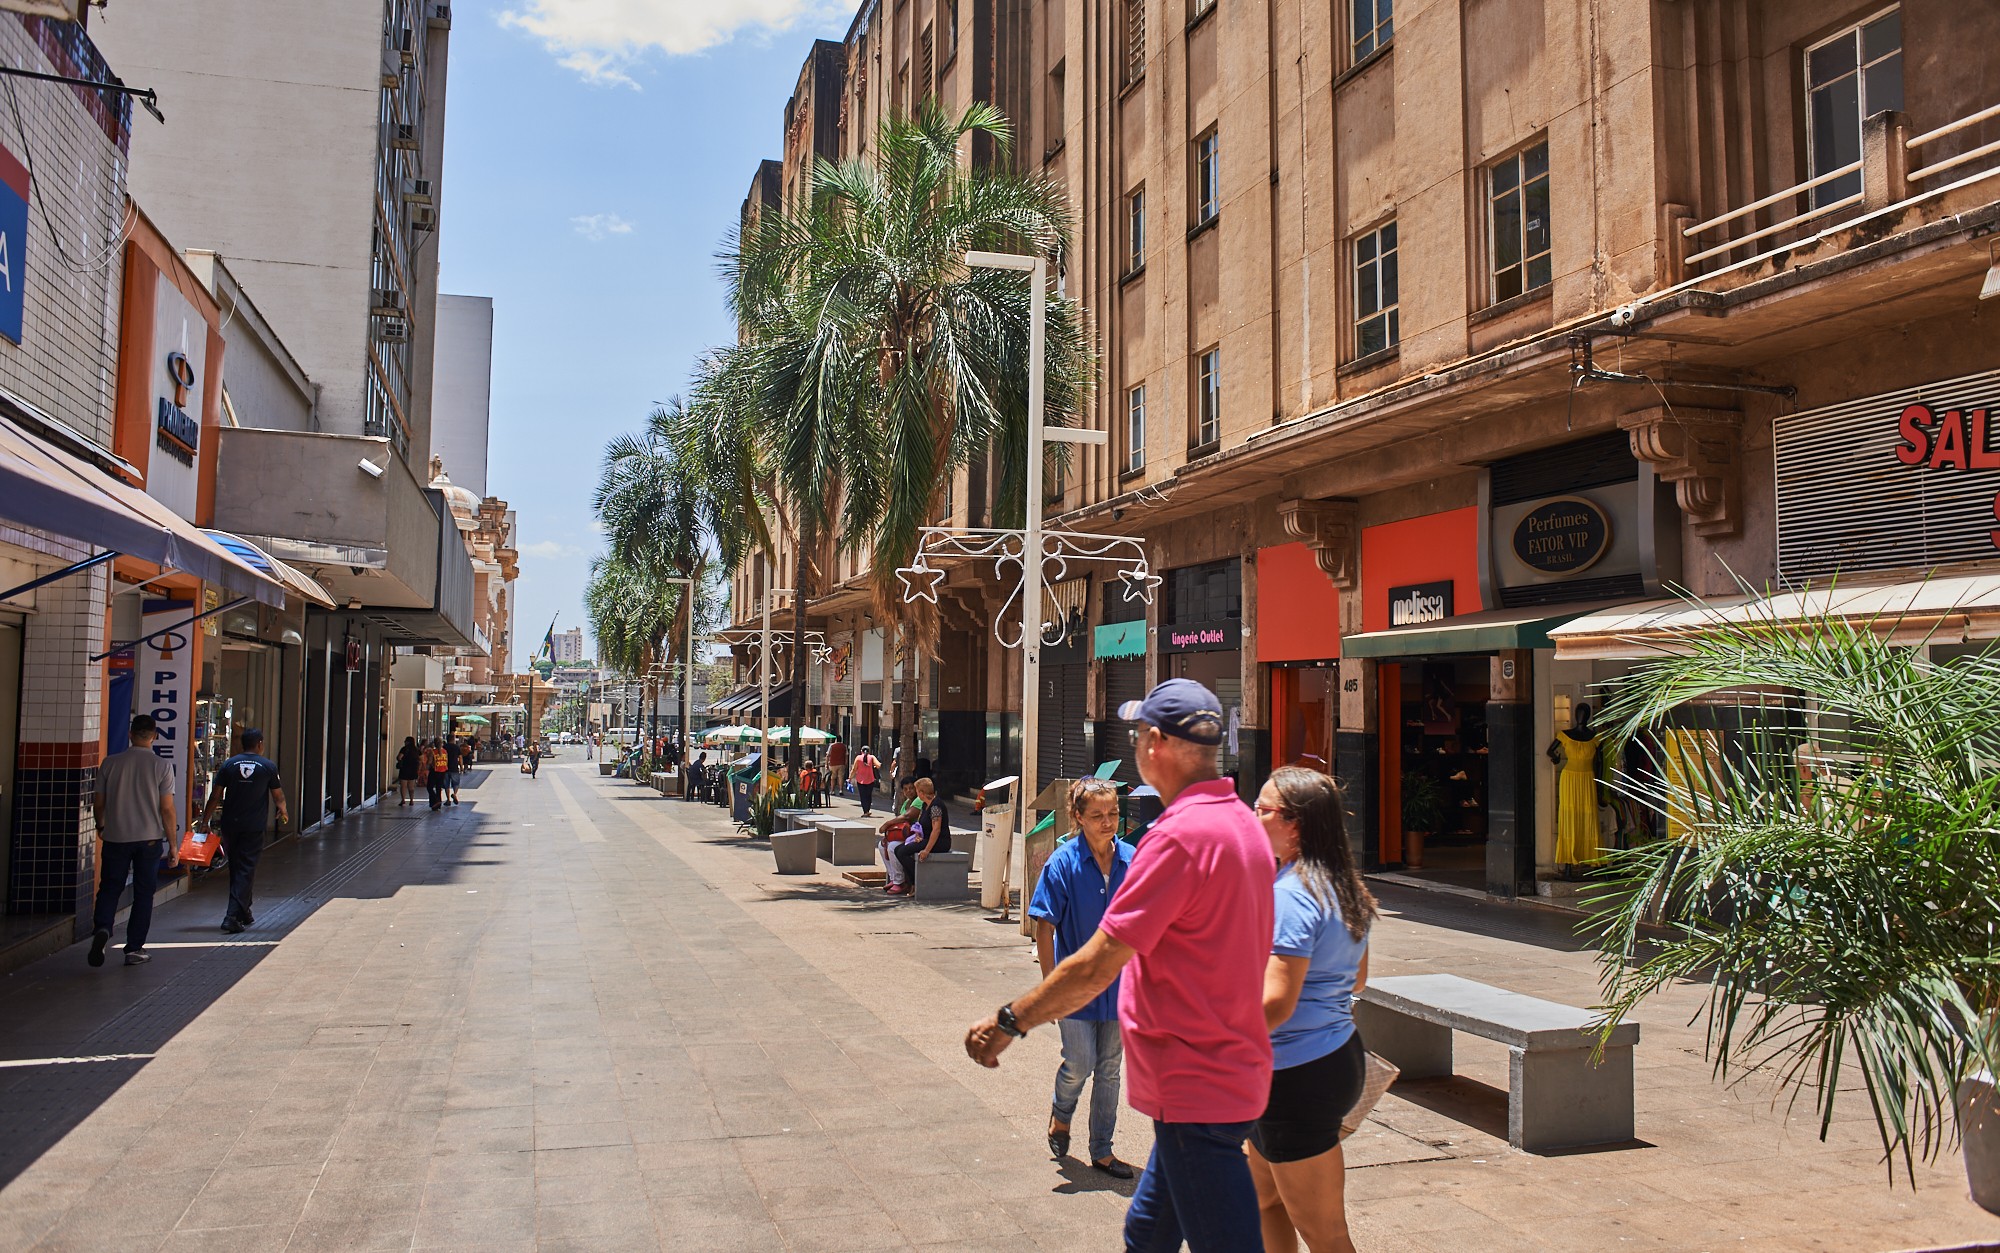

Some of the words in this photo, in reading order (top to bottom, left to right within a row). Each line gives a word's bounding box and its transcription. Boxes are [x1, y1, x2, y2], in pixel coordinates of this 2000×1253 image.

[1528, 512, 1589, 533] Perfumes
[1528, 534, 1564, 554] FATOR
[1568, 531, 1589, 548] VIP
[1546, 553, 1575, 565] BRASIL
[1393, 590, 1444, 626] melissa
[1171, 630, 1198, 648] Lingerie
[1200, 629, 1224, 643] Outlet
[1343, 679, 1358, 692] 485
